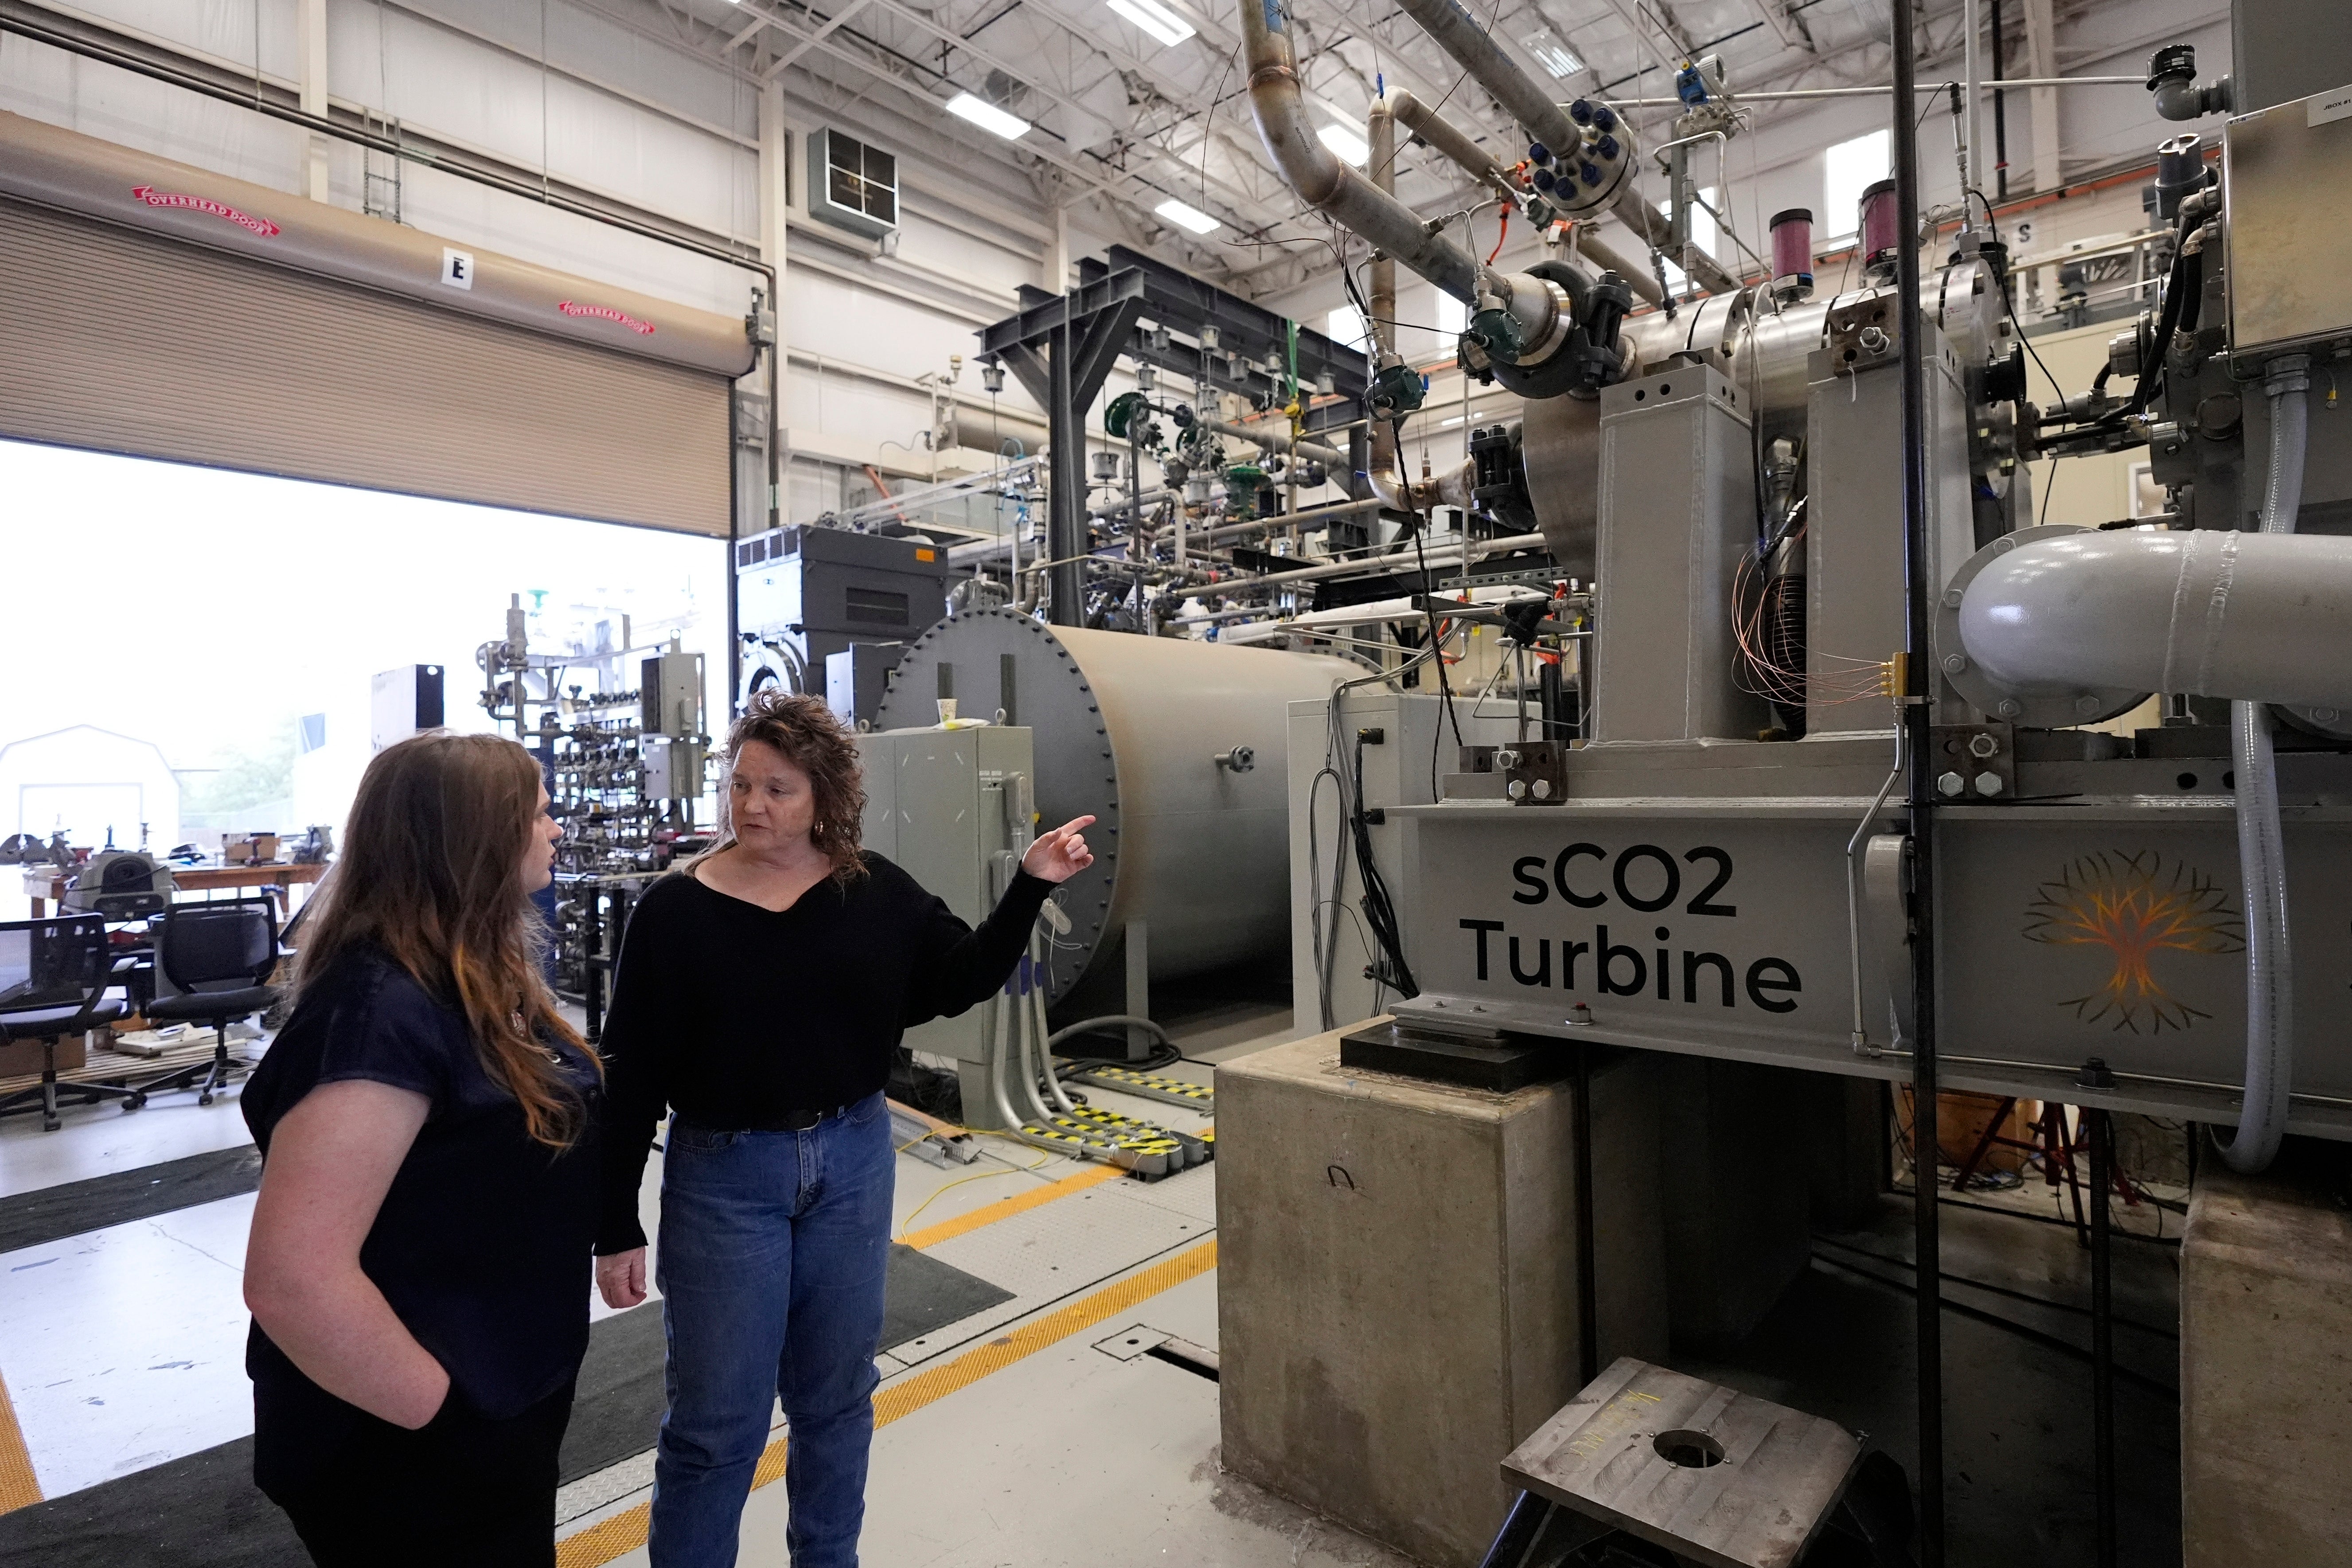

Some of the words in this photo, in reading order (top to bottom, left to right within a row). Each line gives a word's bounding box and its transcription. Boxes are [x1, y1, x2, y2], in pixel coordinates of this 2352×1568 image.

[2324, 101, 2342, 110] JBOX
[149, 196, 227, 215] OVERHEAD
[230, 211, 265, 234] DOOR
[2019, 223, 2031, 242] S
[453, 257, 464, 279] E
[568, 308, 620, 320] OVERHEAD
[621, 316, 646, 332] DOOR
[1512, 843, 1737, 917] sCO2
[1459, 919, 1802, 1013] Turbine
